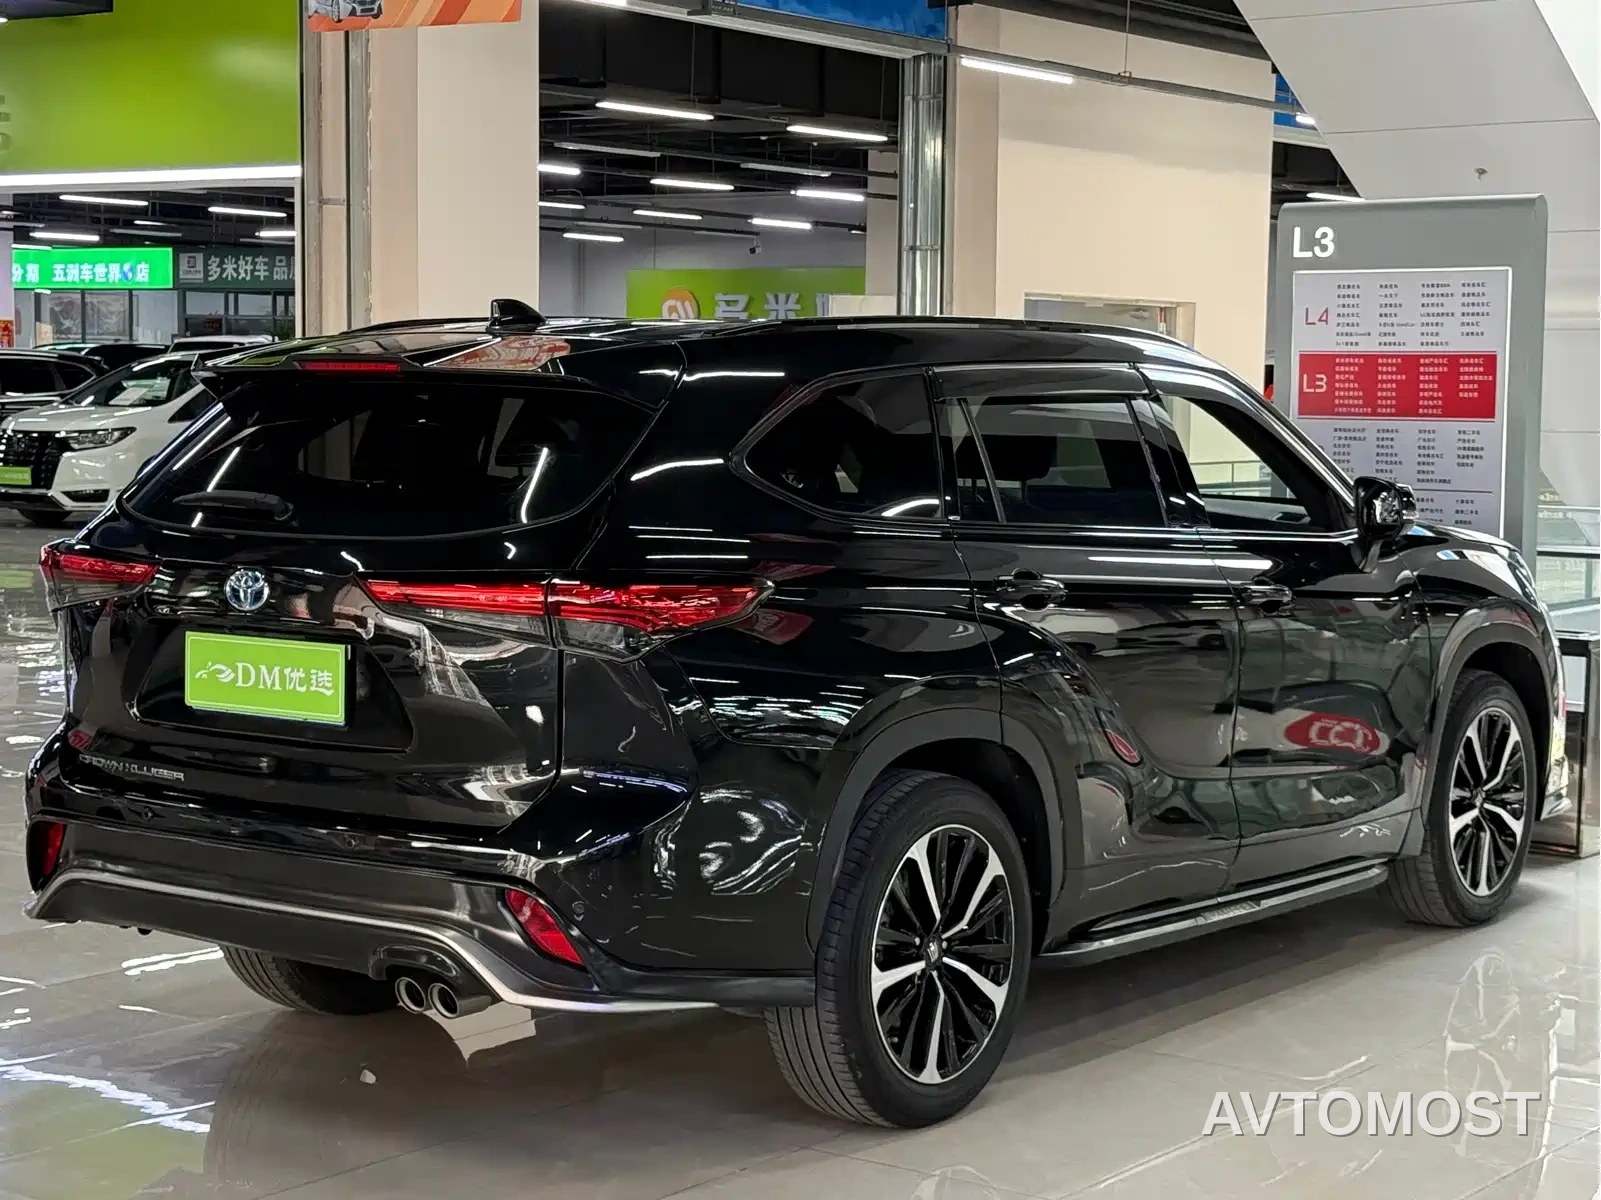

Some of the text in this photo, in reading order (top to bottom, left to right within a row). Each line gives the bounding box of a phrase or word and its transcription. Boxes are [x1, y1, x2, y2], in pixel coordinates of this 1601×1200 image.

[1292, 226, 1335, 258] L3
[1304, 306, 1329, 326] L4
[1302, 373, 1327, 393] L3
[235, 661, 335, 697] DM优选
